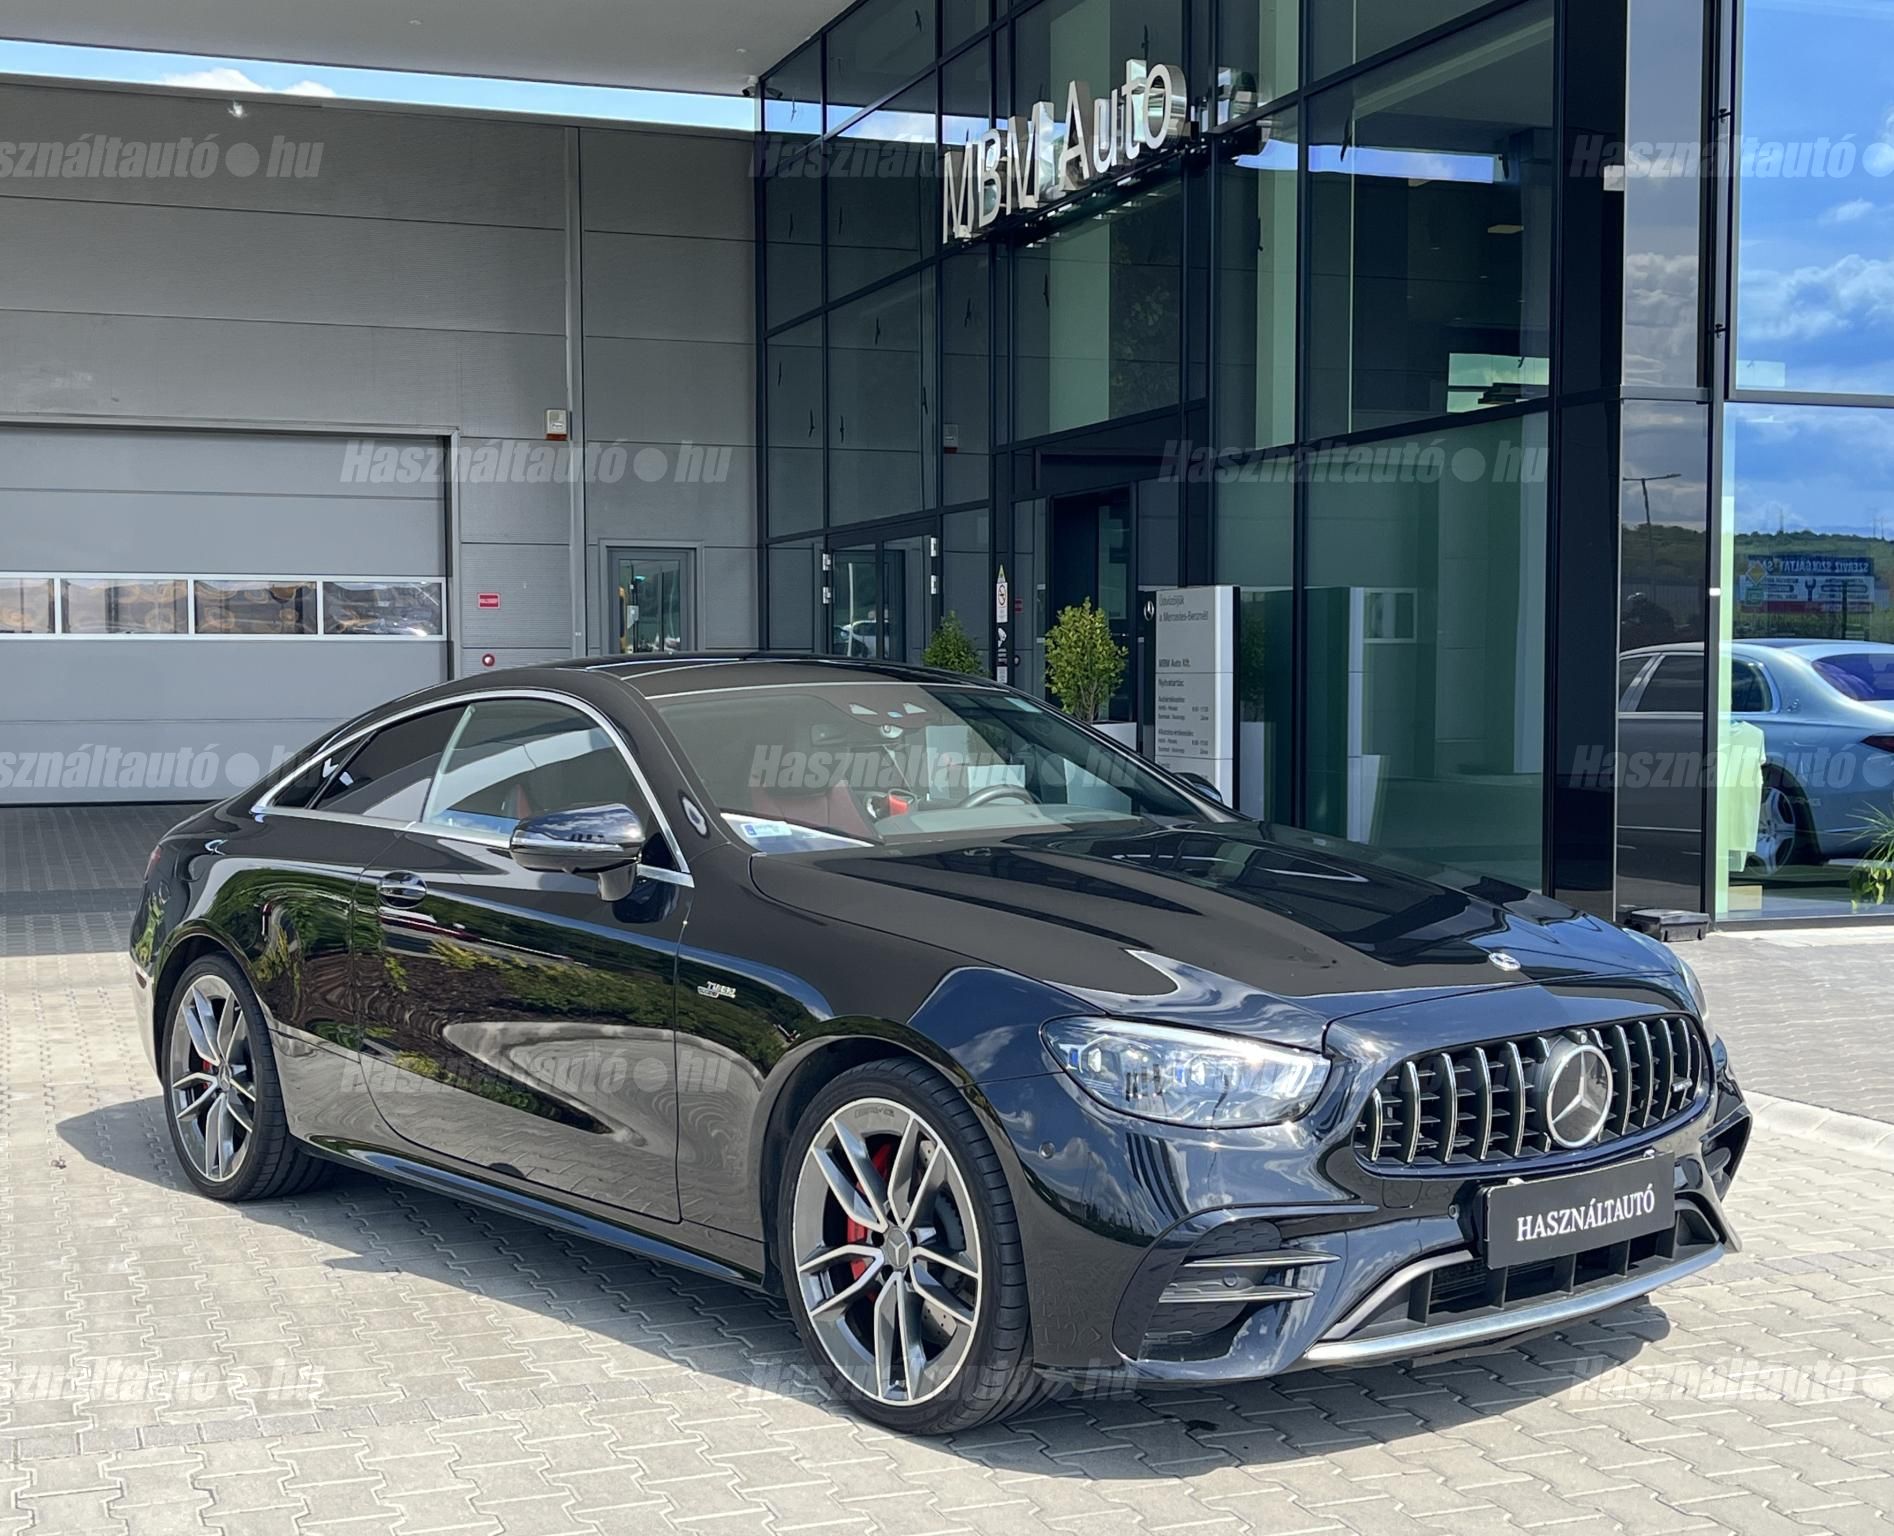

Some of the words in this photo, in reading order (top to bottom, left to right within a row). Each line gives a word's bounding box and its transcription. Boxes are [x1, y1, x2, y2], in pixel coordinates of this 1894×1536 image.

[943, 102, 1051, 244] MBM
[1059, 60, 1185, 190] Auto
[1516, 1183, 1655, 1242] HASZNÁLTAUTÓ
